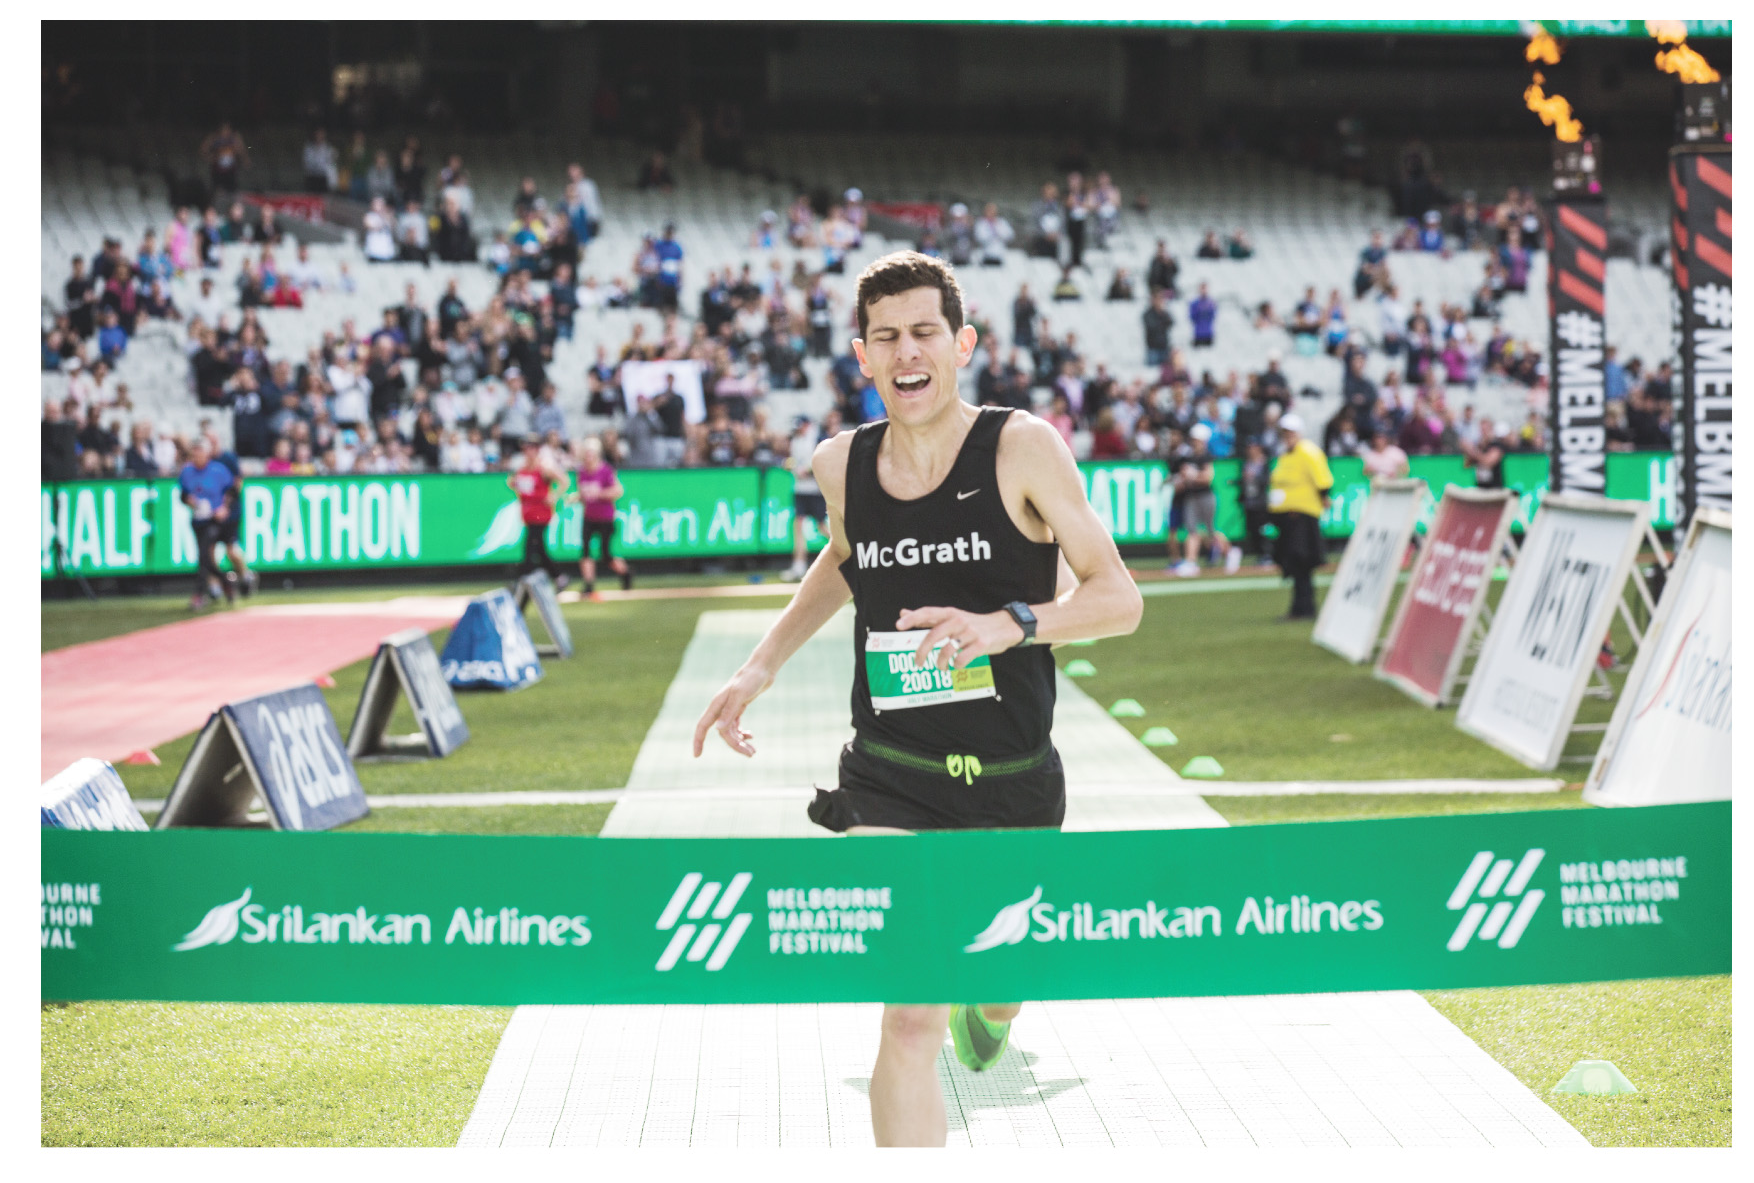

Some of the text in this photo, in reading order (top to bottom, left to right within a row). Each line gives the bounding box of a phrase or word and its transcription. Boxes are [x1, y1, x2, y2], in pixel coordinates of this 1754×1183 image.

[857, 531, 991, 569] McGrath
[1560, 856, 1688, 883] MELBOURNE
[769, 885, 892, 910] MELBOURNE
[1560, 880, 1680, 906] MARATHON
[239, 905, 593, 947] SriLankan Airlines
[769, 909, 885, 933] MARATHON
[1030, 894, 1384, 942] SriLankan Airlines
[1562, 904, 1664, 928] FESTIVAL
[769, 933, 868, 955] FESTIVAL
